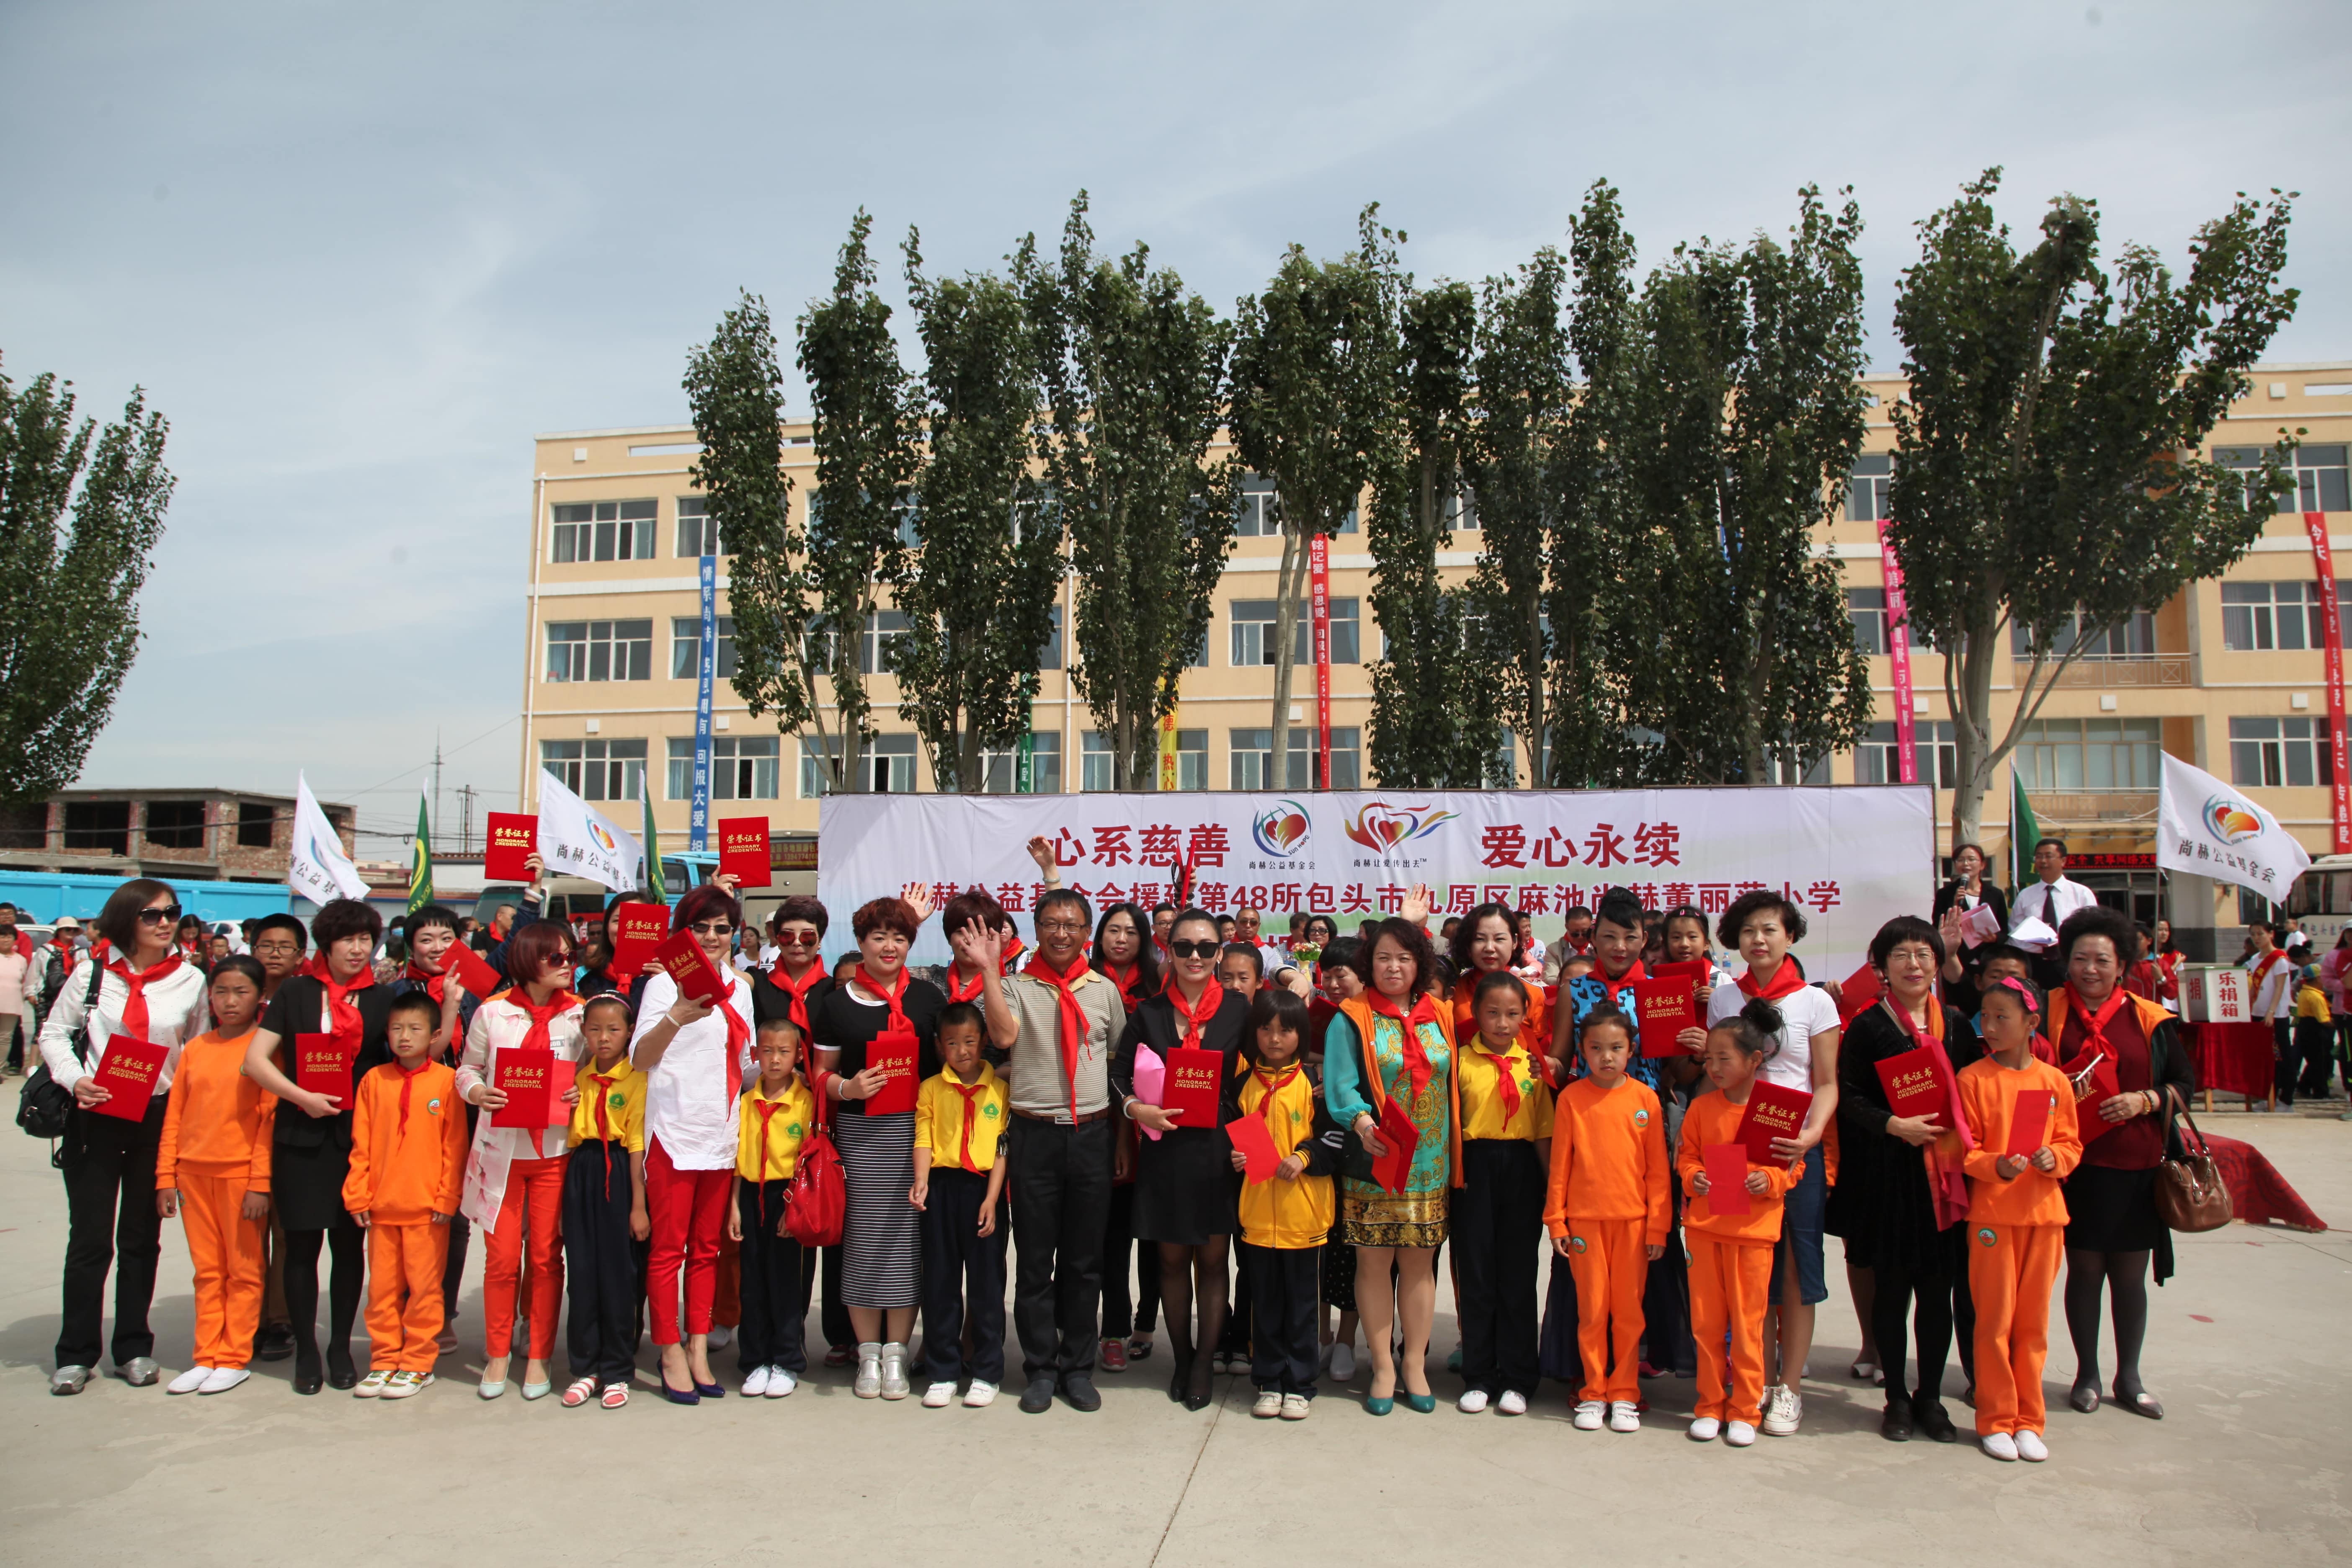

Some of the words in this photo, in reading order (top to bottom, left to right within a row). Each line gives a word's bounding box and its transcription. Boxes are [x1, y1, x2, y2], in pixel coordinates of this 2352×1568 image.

[495, 828, 530, 838] 荣誉证书
[727, 833, 762, 843] 荣誉证书
[1047, 823, 1230, 867] 心系慈善
[1481, 822, 1681, 869] 爱心永续
[1249, 861, 1315, 870] 尚赫公益基金会
[1354, 859, 1420, 868] 尚赫让爱传出去
[2179, 839, 2275, 883] 尚赫公益基金会
[290, 854, 346, 898] 公益基
[626, 920, 661, 931] 荣誉证书
[669, 949, 694, 970] 荣誉证书
[676, 960, 697, 975] HONORARY
[677, 964, 701, 979] CREDENTIAL
[1645, 995, 1684, 1008] 荣誉证书
[2219, 972, 2238, 1017] 乐捐箱
[111, 1055, 155, 1072] 荣誉证书
[305, 1052, 342, 1062] 荣誉证书
[108, 1070, 148, 1083] CREDENTIAL
[110, 1067, 147, 1078] HONORARY
[503, 1066, 544, 1078] 荣誉证书
[1176, 1067, 1214, 1078] 荣誉证书
[1893, 1067, 1932, 1088] 荣誉证书
[1897, 1080, 1932, 1094] HONORARY
[1898, 1083, 1937, 1099] CREDENTIAL
[1757, 1102, 1798, 1121] 荣誉证书
[1753, 1117, 1792, 1131] CREDENTIAL
[1756, 1114, 1792, 1127] HONORARY
